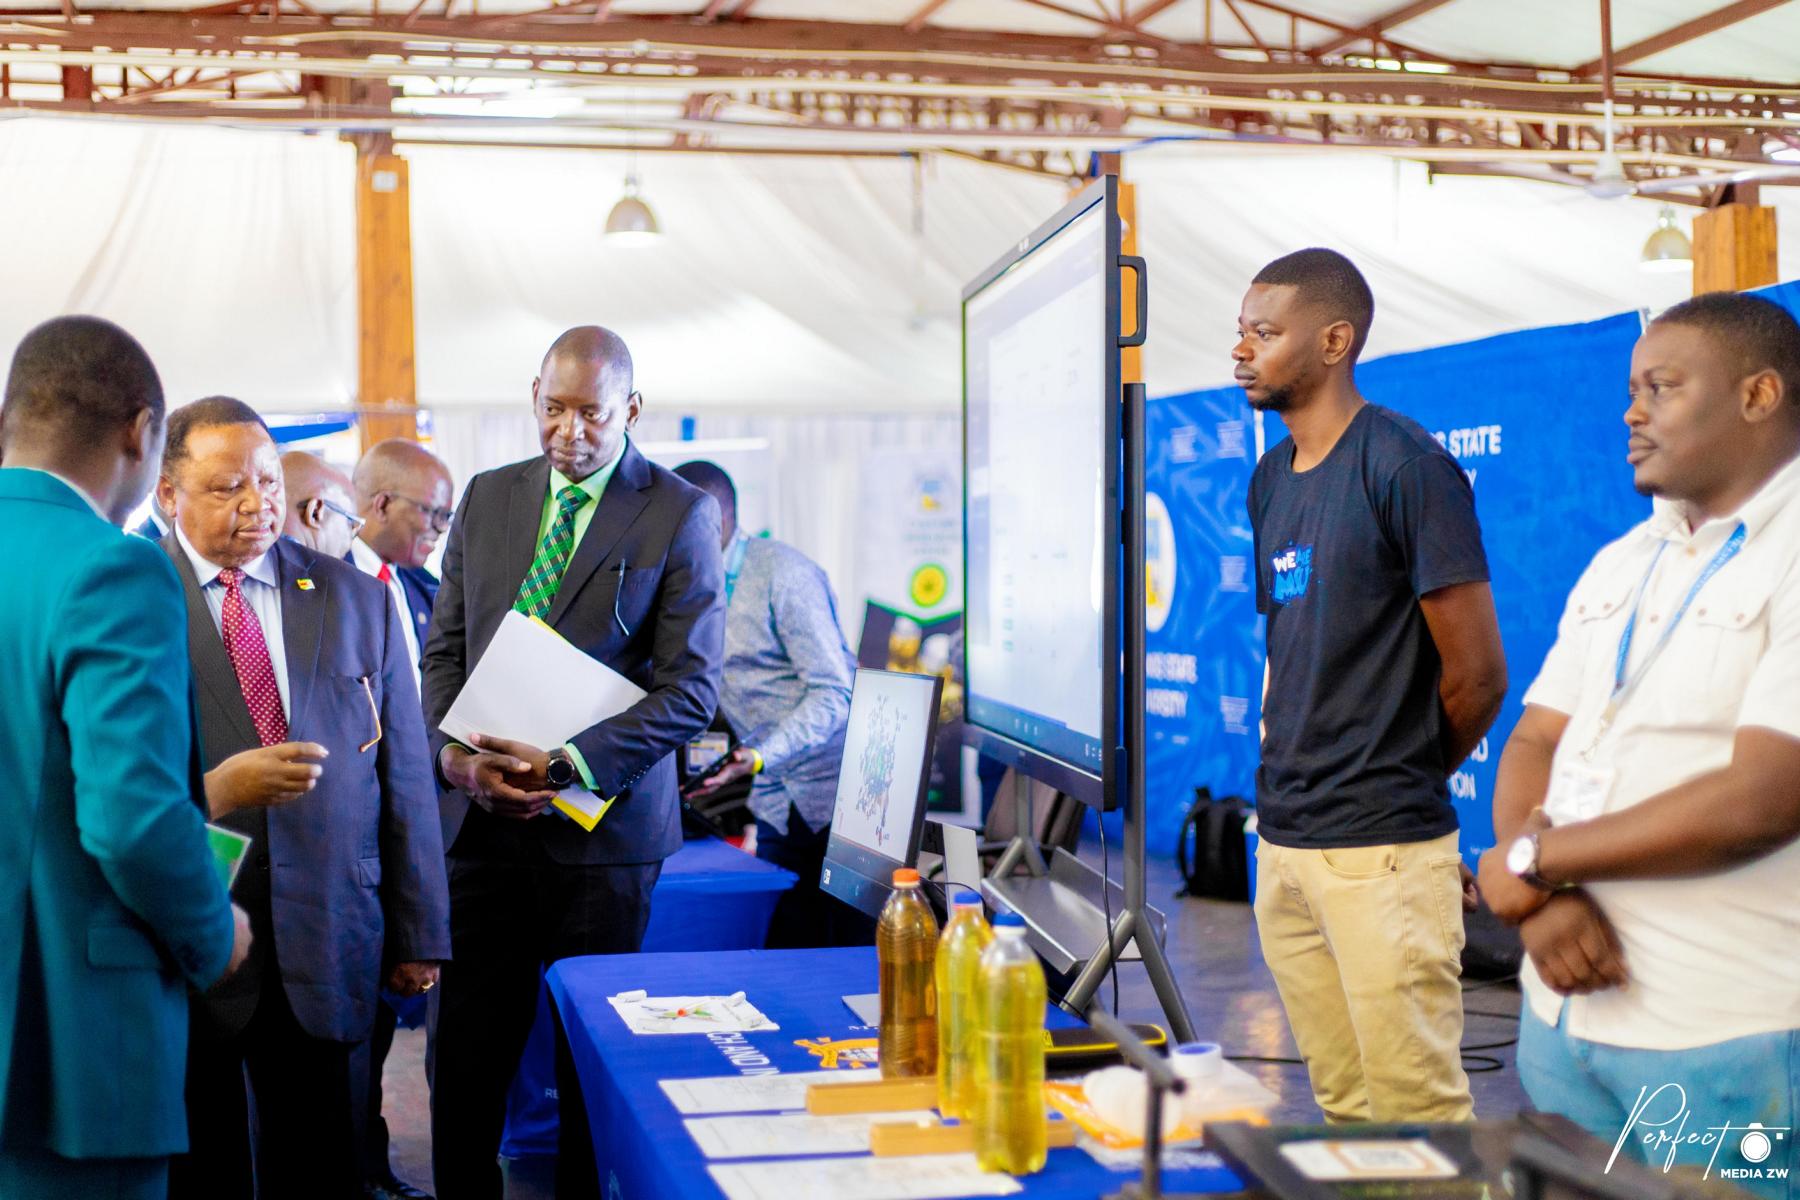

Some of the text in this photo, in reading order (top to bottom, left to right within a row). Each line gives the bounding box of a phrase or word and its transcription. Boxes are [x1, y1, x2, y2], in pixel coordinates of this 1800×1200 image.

[1449, 425, 1502, 458] STATE
[1273, 553, 1296, 573] WE
[717, 1045, 771, 1066] AND
